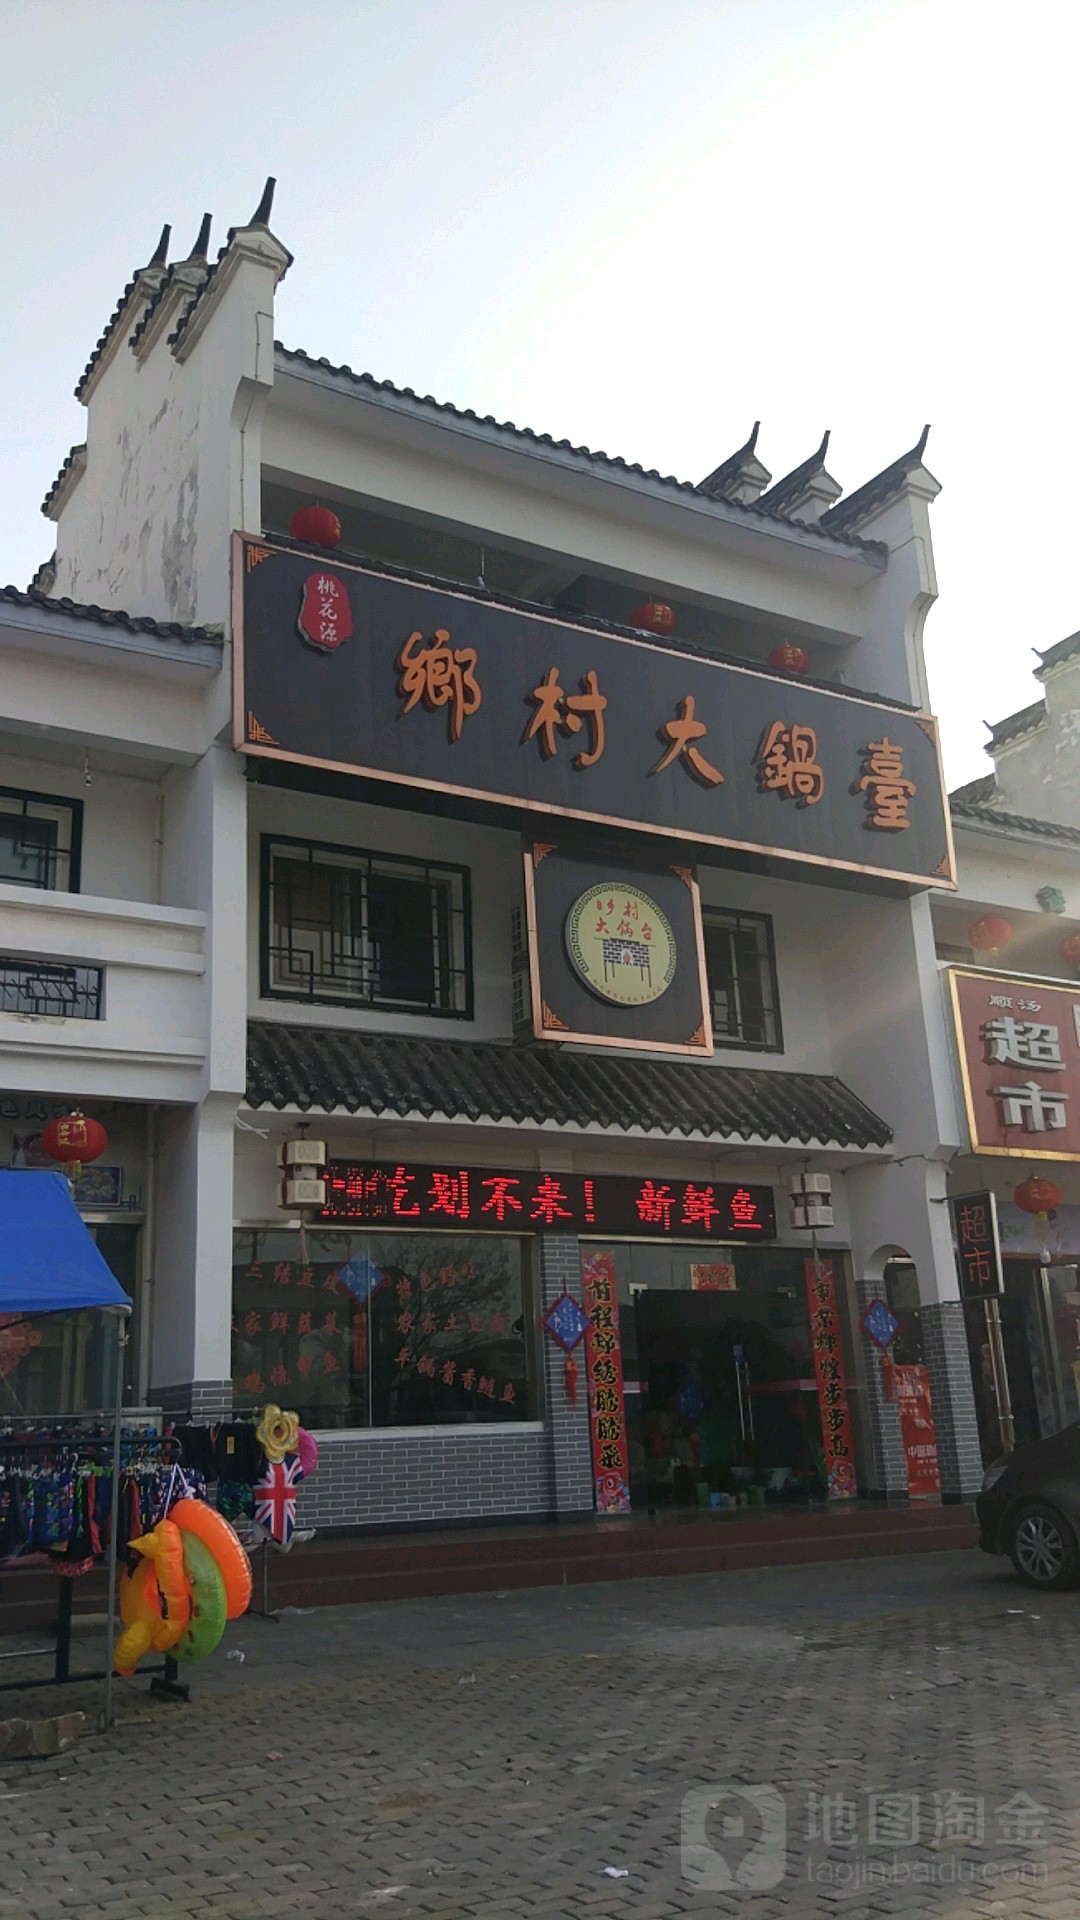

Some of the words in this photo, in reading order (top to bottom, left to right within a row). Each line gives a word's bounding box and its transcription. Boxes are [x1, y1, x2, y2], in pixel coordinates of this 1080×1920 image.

[317, 575, 340, 632] 桃花源
[594, 917, 652, 940] 大锅台
[986, 1016, 1070, 1132] 超市
[635, 1179, 763, 1232] 新鲜鱼
[960, 1205, 991, 1289] 超市
